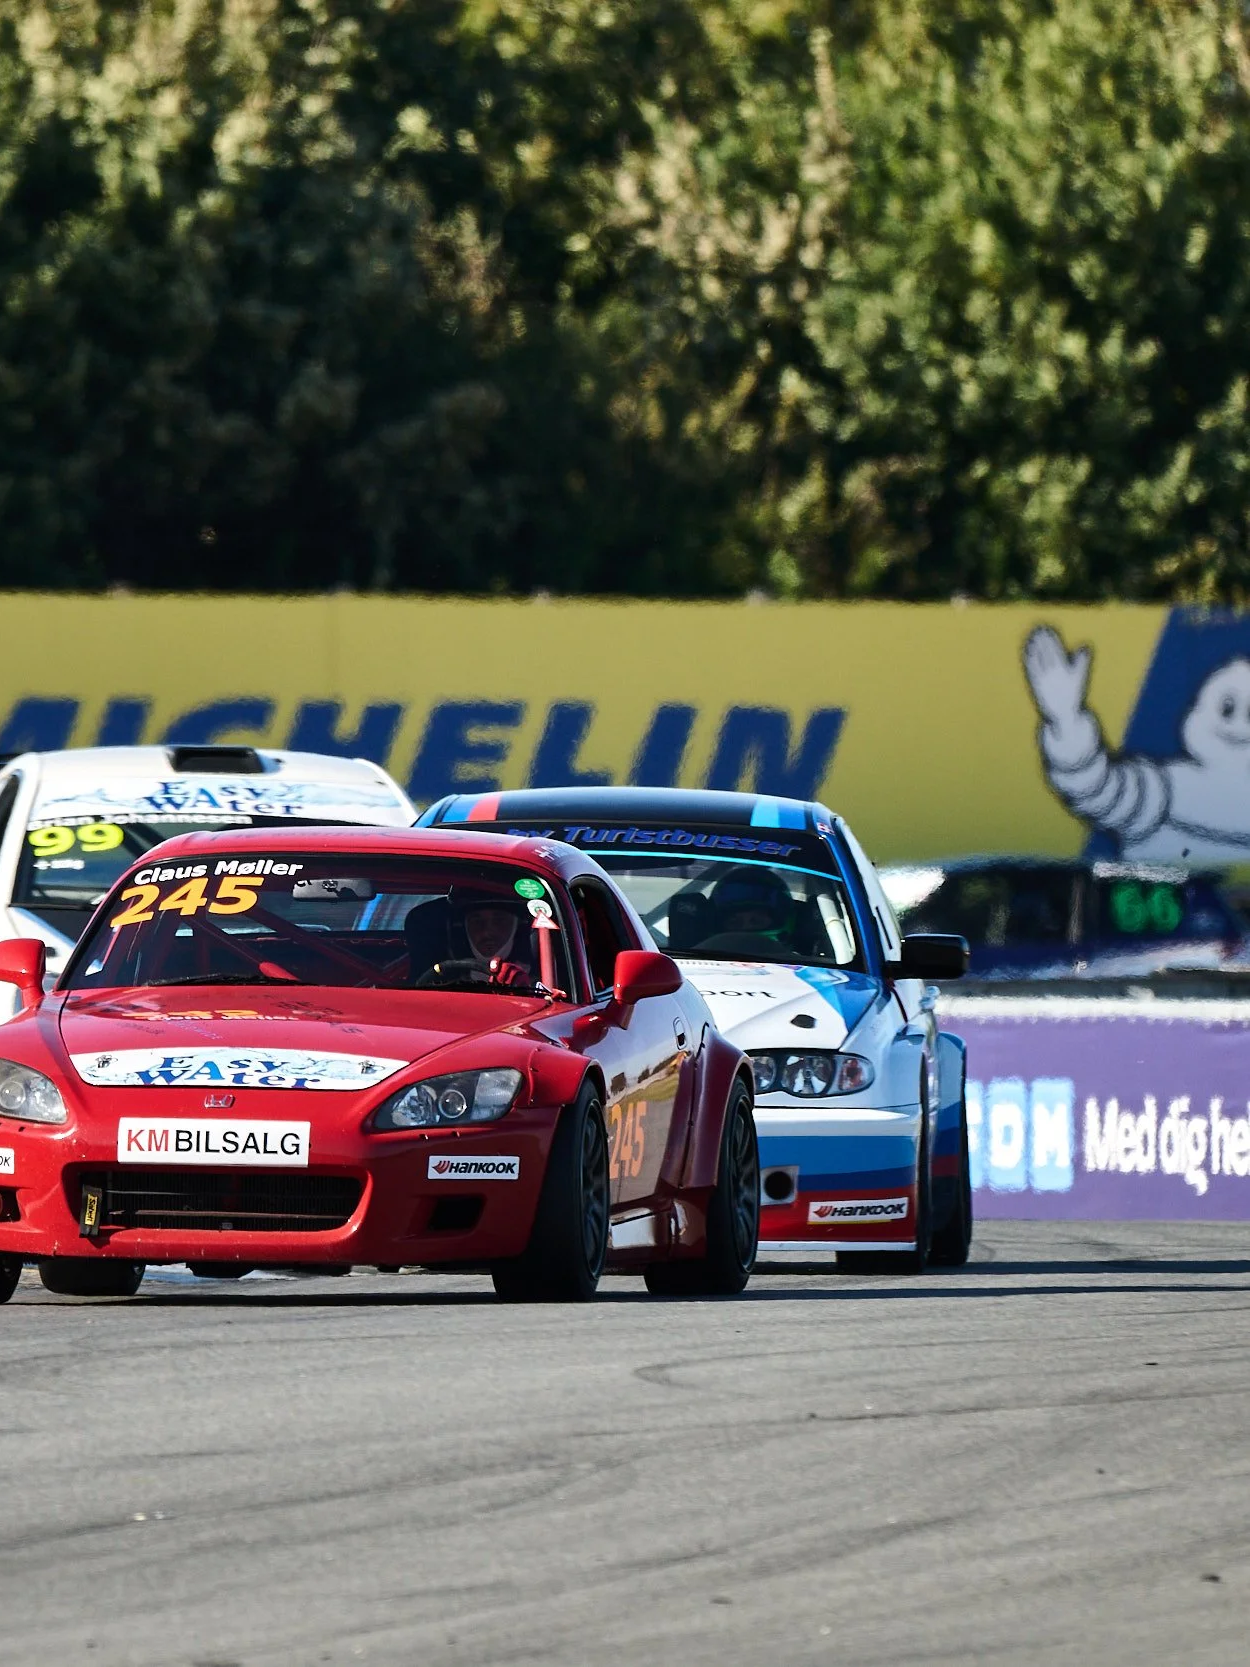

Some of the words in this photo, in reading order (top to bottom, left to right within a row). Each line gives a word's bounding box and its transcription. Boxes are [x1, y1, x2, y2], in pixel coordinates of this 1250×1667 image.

[27, 823, 125, 857] 99
[563, 825, 802, 858] Turistbusser
[134, 863, 209, 886] Claus
[213, 859, 304, 877] Møller
[109, 875, 265, 928] 245
[698, 990, 777, 999] port
[608, 1100, 647, 1179] 245
[1083, 1095, 1157, 1174] Med
[1158, 1095, 1209, 1197] dig
[1210, 1095, 1250, 1177] he
